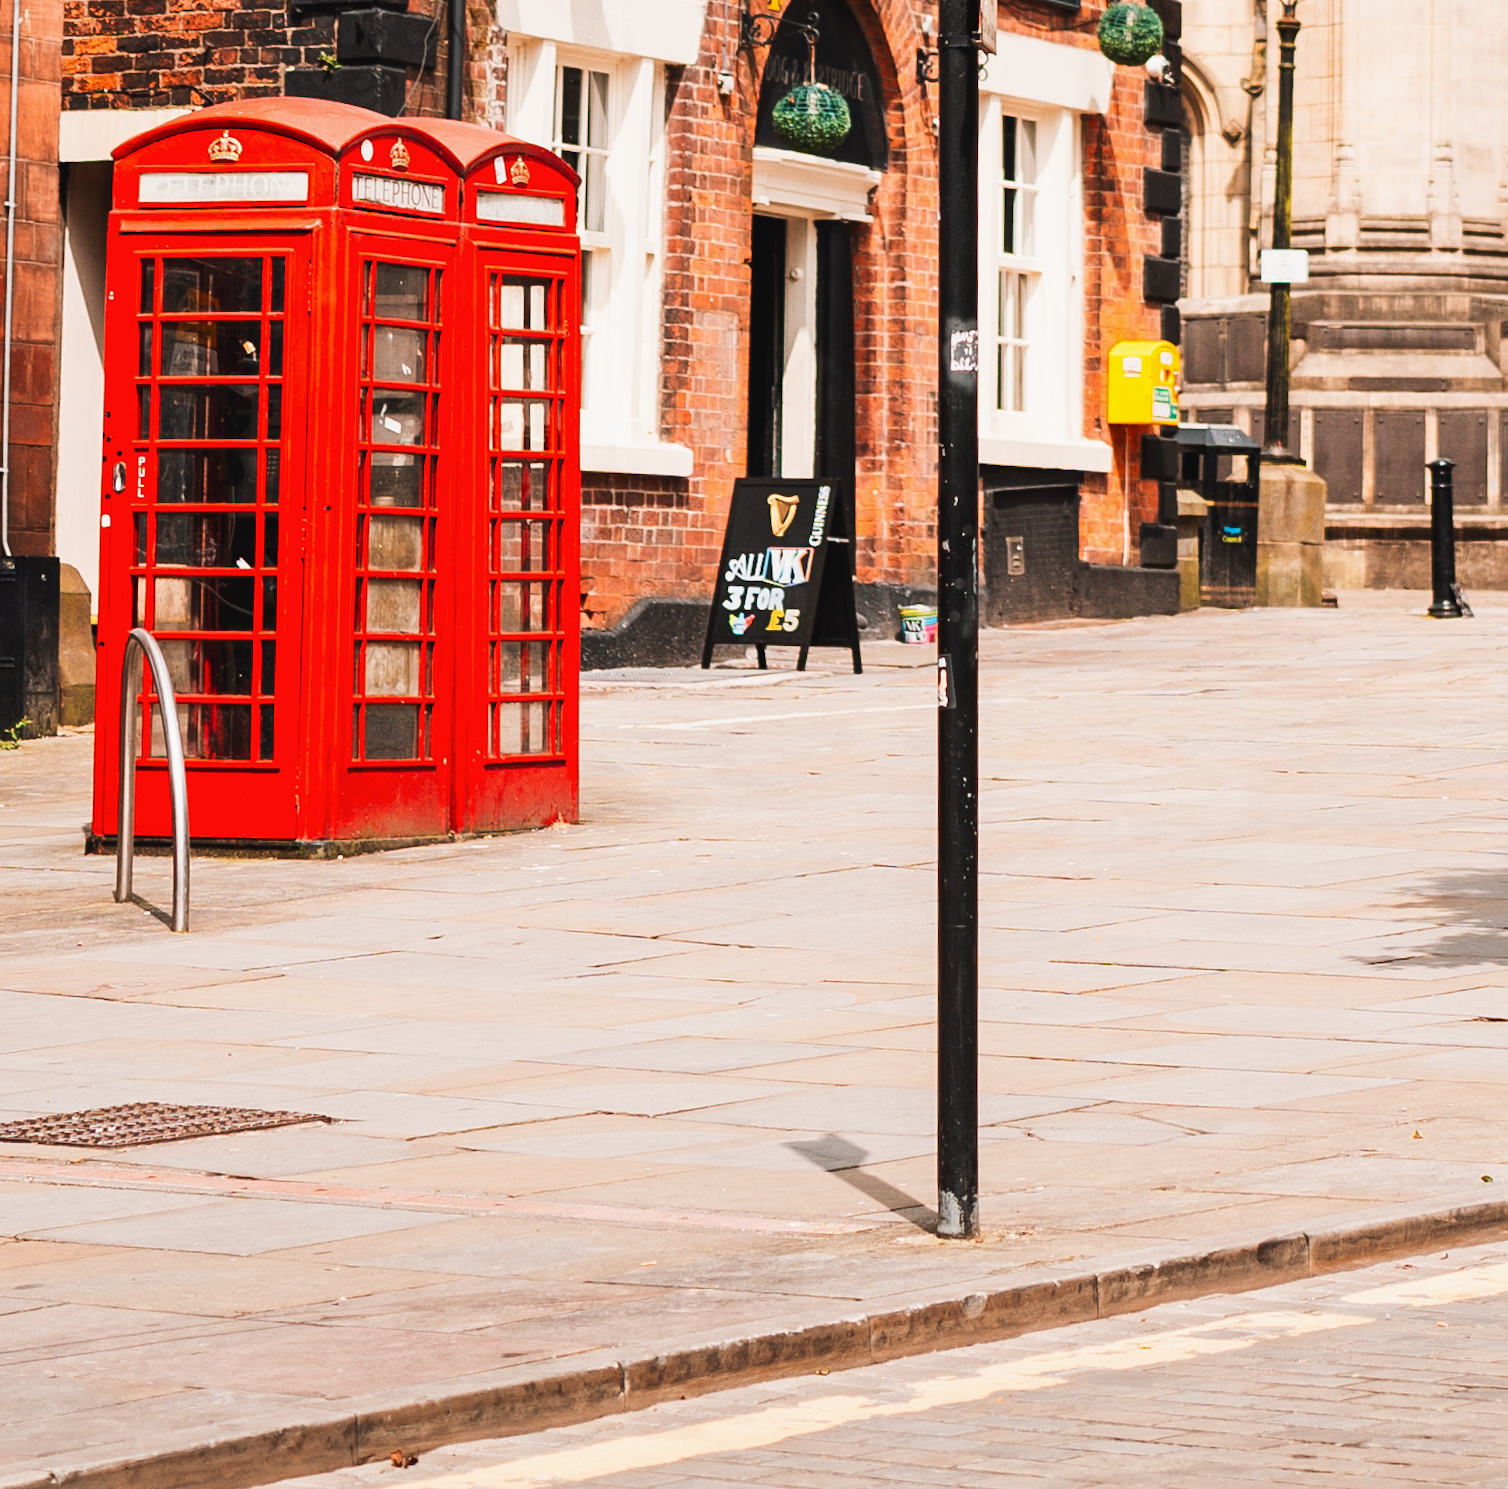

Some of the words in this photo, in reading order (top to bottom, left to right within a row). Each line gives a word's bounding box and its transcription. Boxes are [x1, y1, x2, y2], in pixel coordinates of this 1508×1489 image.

[765, 54, 789, 84] DOG
[803, 62, 865, 102] PRTRIDGE
[353, 174, 440, 210] TELEPHONE
[136, 455, 145, 498] PULL
[808, 485, 832, 547] GUINNESS
[724, 552, 765, 582] ALL
[769, 548, 809, 584] VK
[722, 585, 745, 611] 3
[744, 586, 785, 611] FOR
[765, 608, 801, 632] £5
